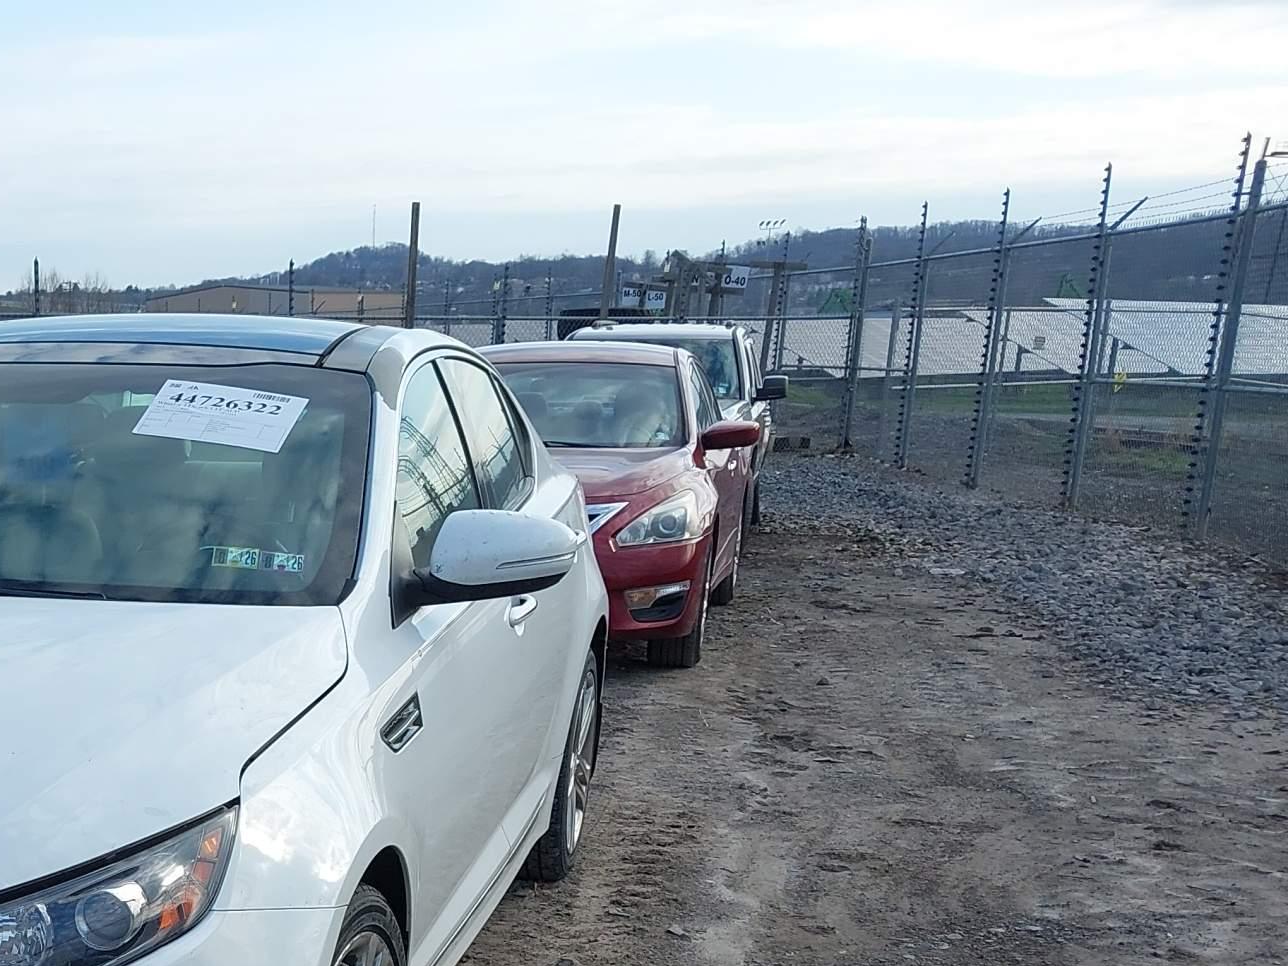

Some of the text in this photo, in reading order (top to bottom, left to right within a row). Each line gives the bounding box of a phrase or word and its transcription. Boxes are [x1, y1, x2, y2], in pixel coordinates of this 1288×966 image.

[724, 275, 746, 286] O-40
[623, 289, 642, 298] M-50
[647, 292, 664, 301] L-50
[169, 392, 283, 416] 44726322
